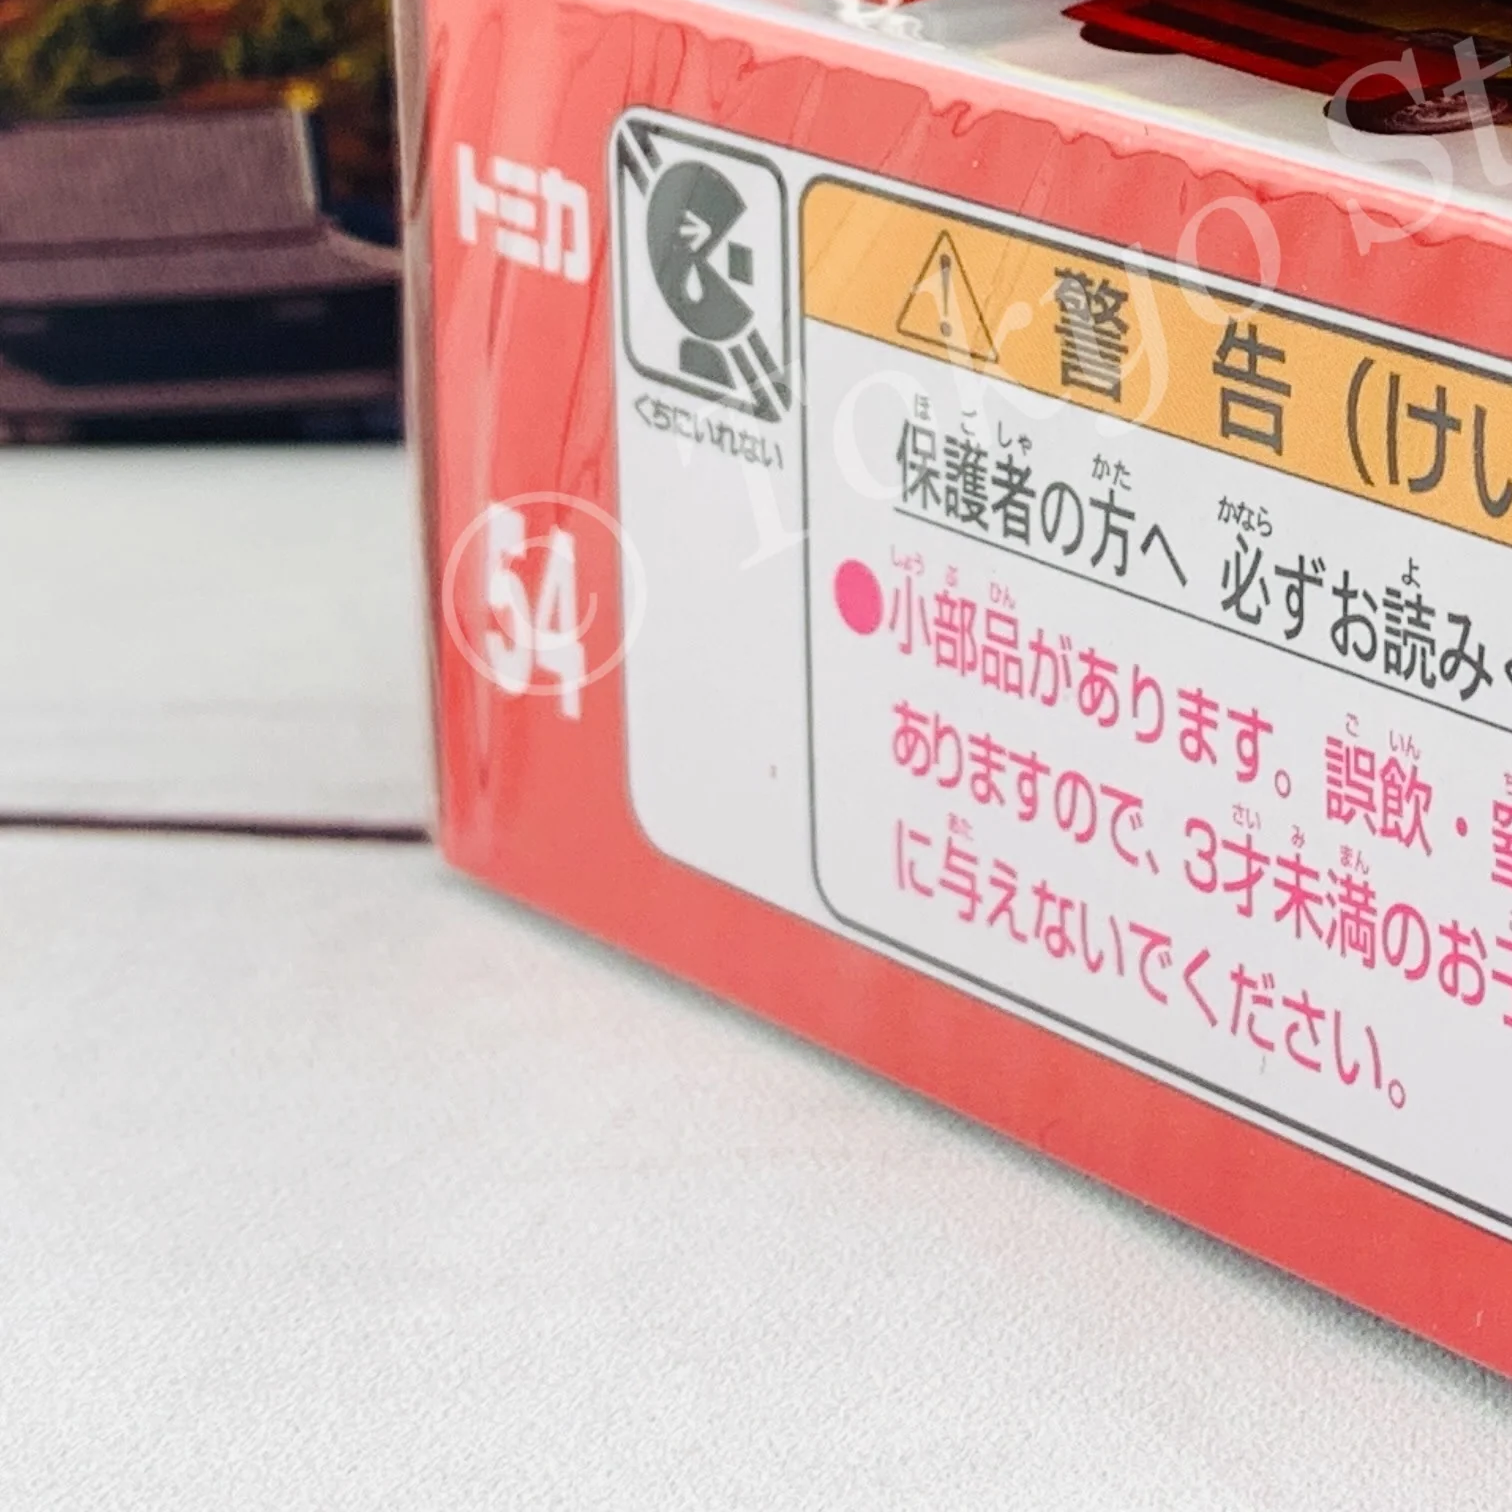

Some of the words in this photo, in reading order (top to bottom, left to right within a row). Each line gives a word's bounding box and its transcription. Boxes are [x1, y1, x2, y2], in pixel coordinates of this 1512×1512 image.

[456, 142, 592, 283] トミカ
[634, 393, 784, 471] くちにいれない
[897, 420, 1188, 587] 保護者の方へ
[486, 501, 585, 720] 54
[897, 818, 1407, 1111] に与えないでください。
